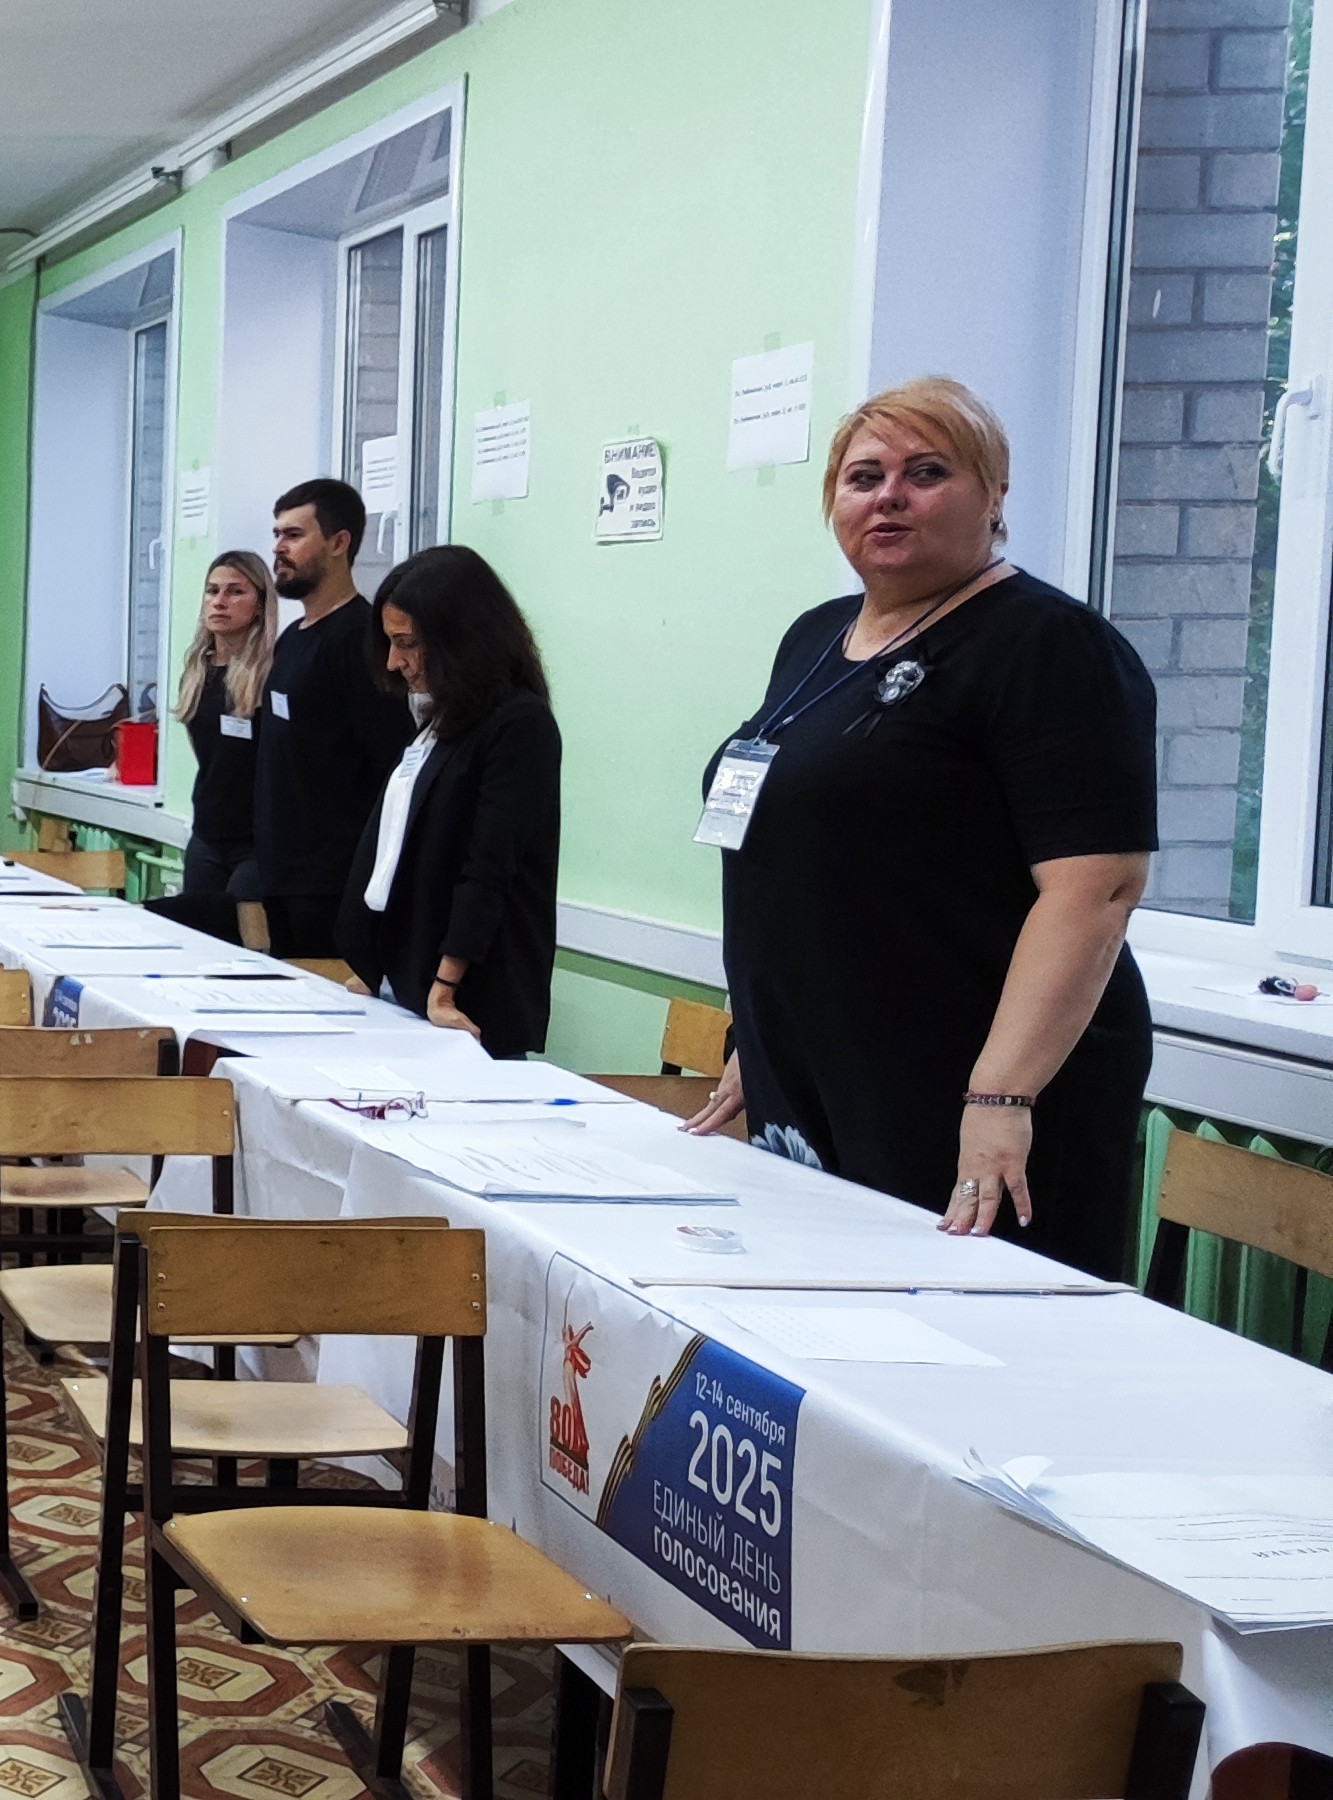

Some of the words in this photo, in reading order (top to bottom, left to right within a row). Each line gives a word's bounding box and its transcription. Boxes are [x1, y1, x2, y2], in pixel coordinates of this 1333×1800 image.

[695, 1371, 724, 1409] 12-14
[726, 1395, 786, 1447] сентября
[687, 1409, 783, 1538] 2025
[653, 1479, 726, 1559] ЕДИНЫЙ
[730, 1531, 782, 1595] ДЕНЬ
